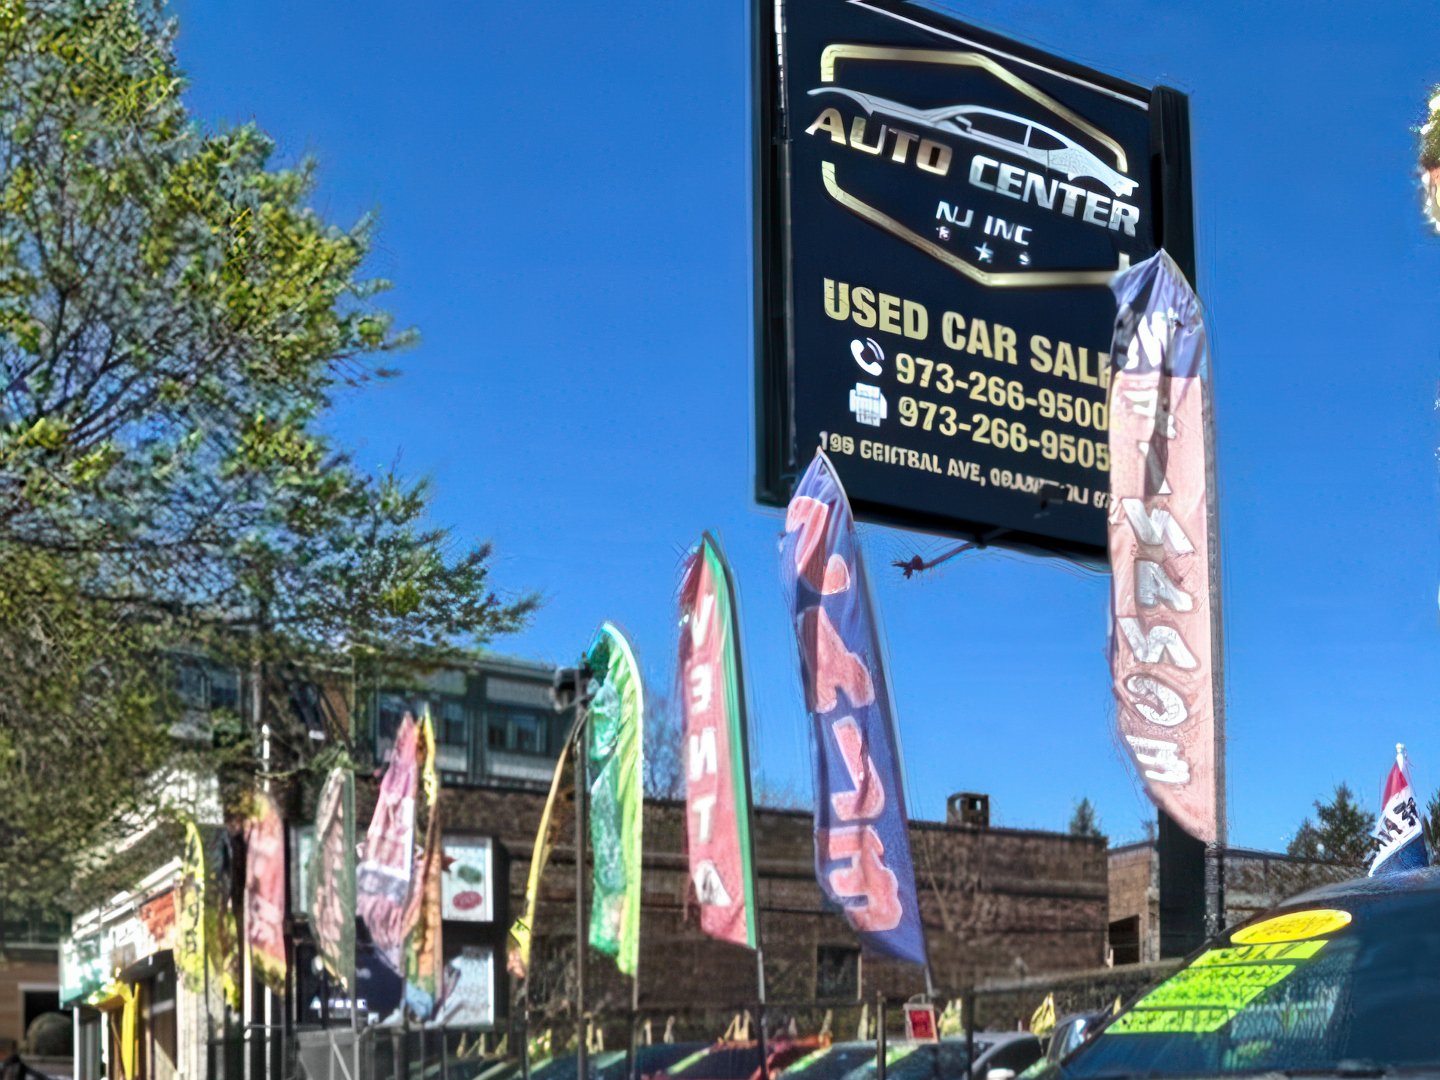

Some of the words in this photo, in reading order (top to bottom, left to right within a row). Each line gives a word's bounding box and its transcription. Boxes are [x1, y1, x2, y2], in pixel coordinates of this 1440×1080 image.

[806, 108, 953, 176] AUTO
[969, 154, 1140, 237] CENTER
[936, 200, 975, 229] NJ
[984, 215, 1033, 246] INC
[824, 277, 928, 340] USED
[942, 310, 1018, 365] CAR
[896, 353, 1110, 431] 973-266-9500
[898, 396, 1111, 472] 973-266-9505
